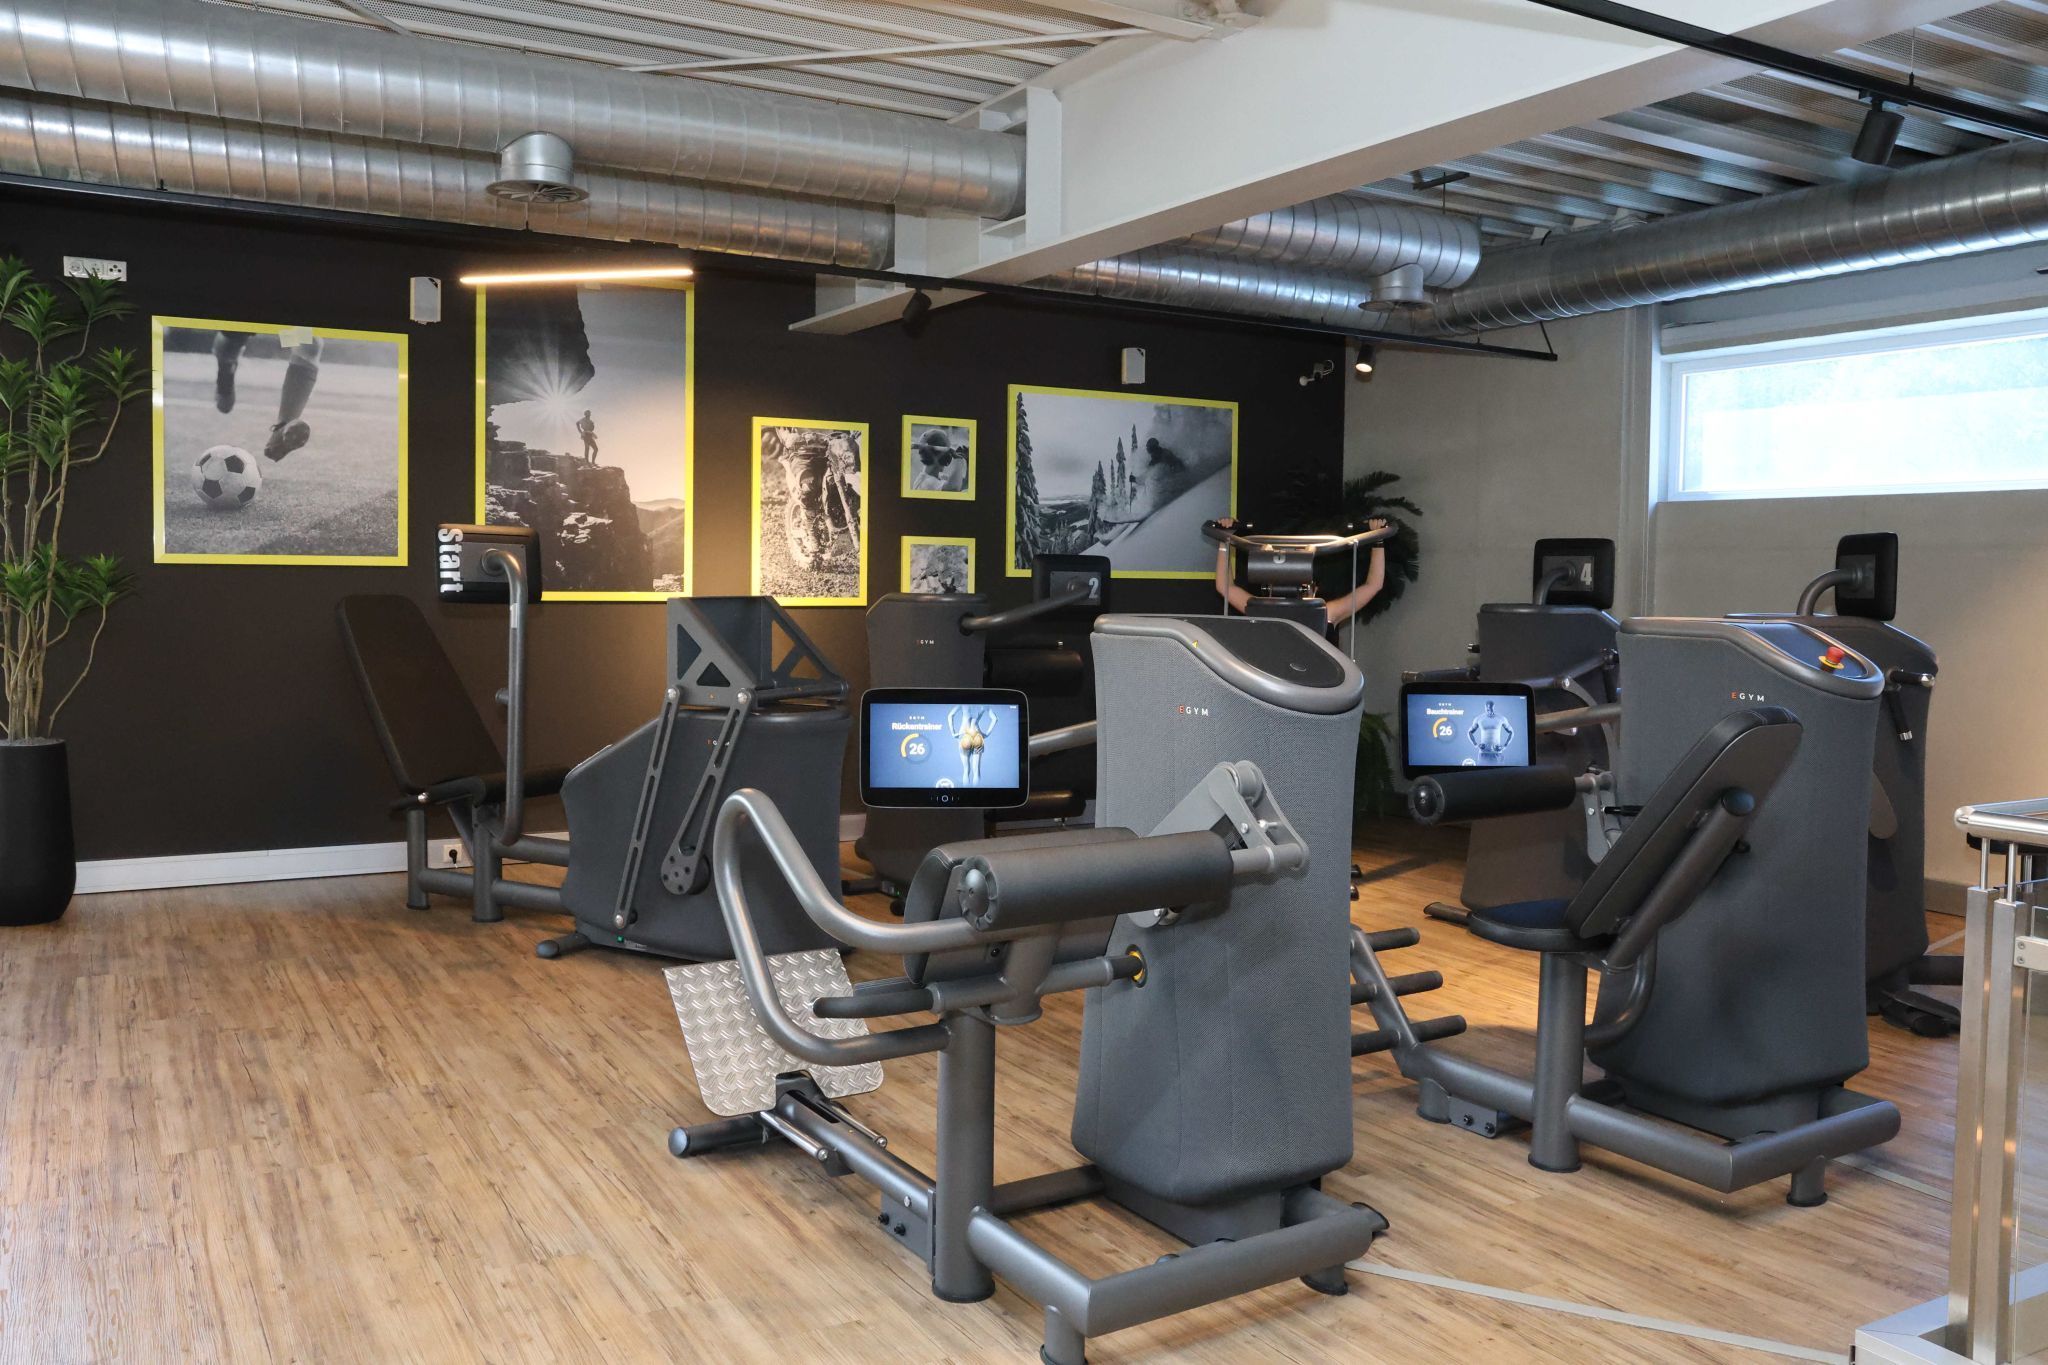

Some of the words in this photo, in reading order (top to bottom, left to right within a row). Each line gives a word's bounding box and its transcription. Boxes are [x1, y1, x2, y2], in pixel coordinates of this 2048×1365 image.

[437, 528, 463, 593] Start
[1580, 562, 1592, 585] 4
[1088, 577, 1099, 599] 2
[1731, 691, 1765, 702] EGYM
[1179, 705, 1209, 717] EGYM
[891, 722, 943, 731] Rückentrainer
[1439, 726, 1453, 736] 26
[908, 743, 926, 756] 26
